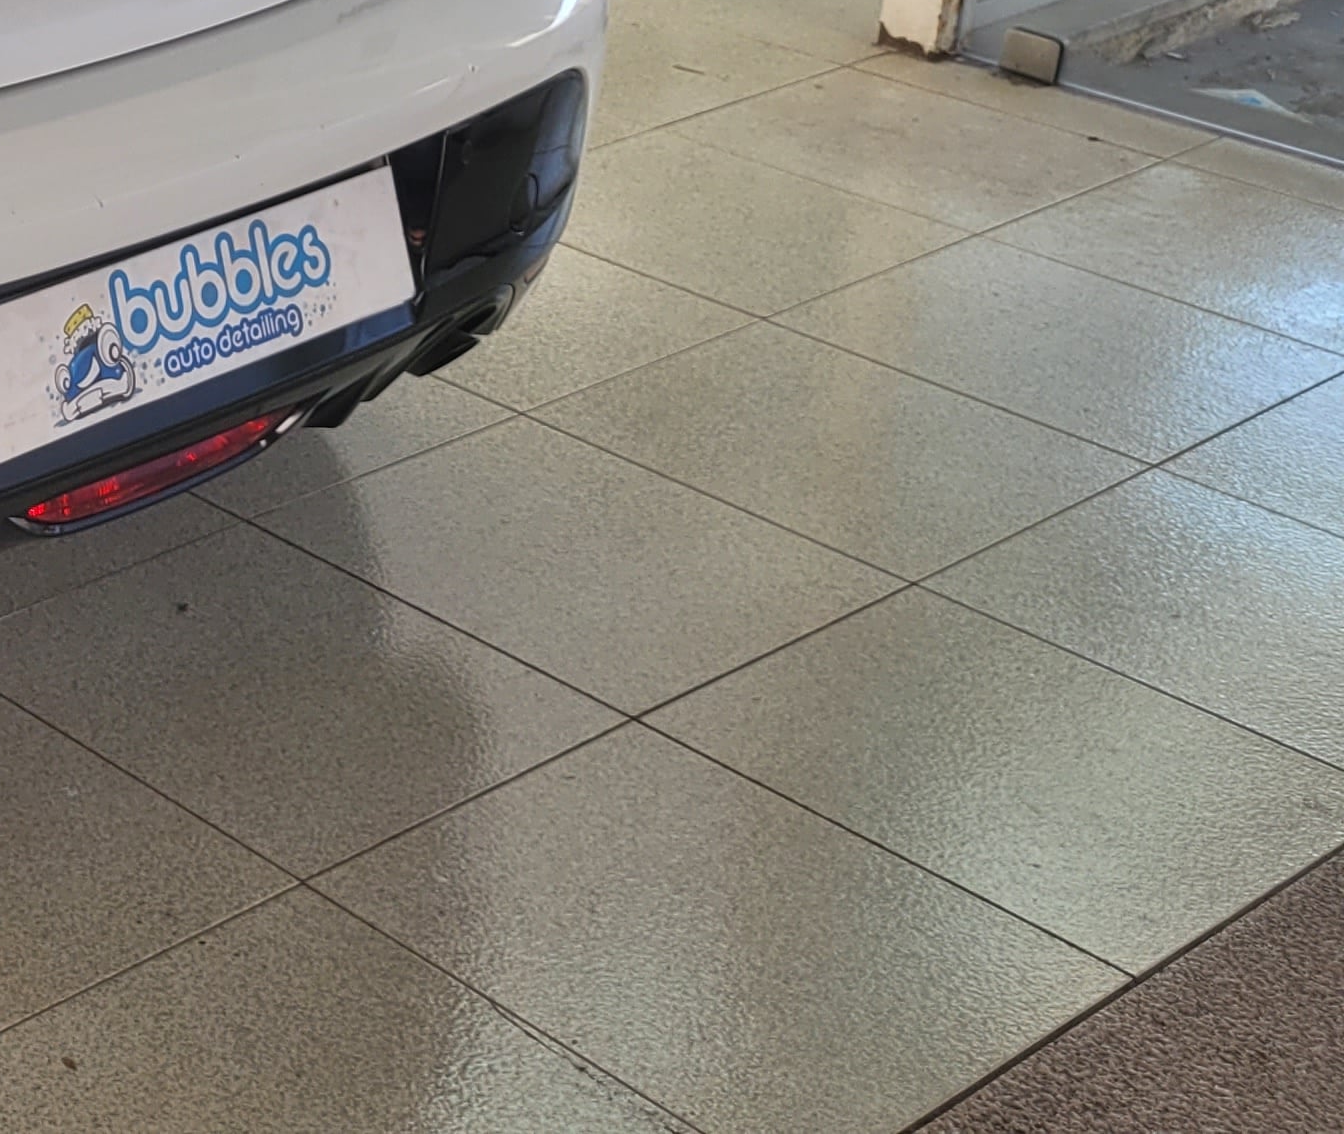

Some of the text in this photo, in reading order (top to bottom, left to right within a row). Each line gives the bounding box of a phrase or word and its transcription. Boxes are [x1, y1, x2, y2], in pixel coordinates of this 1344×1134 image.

[111, 221, 329, 351] bubbles
[166, 306, 302, 375] auto detailing
